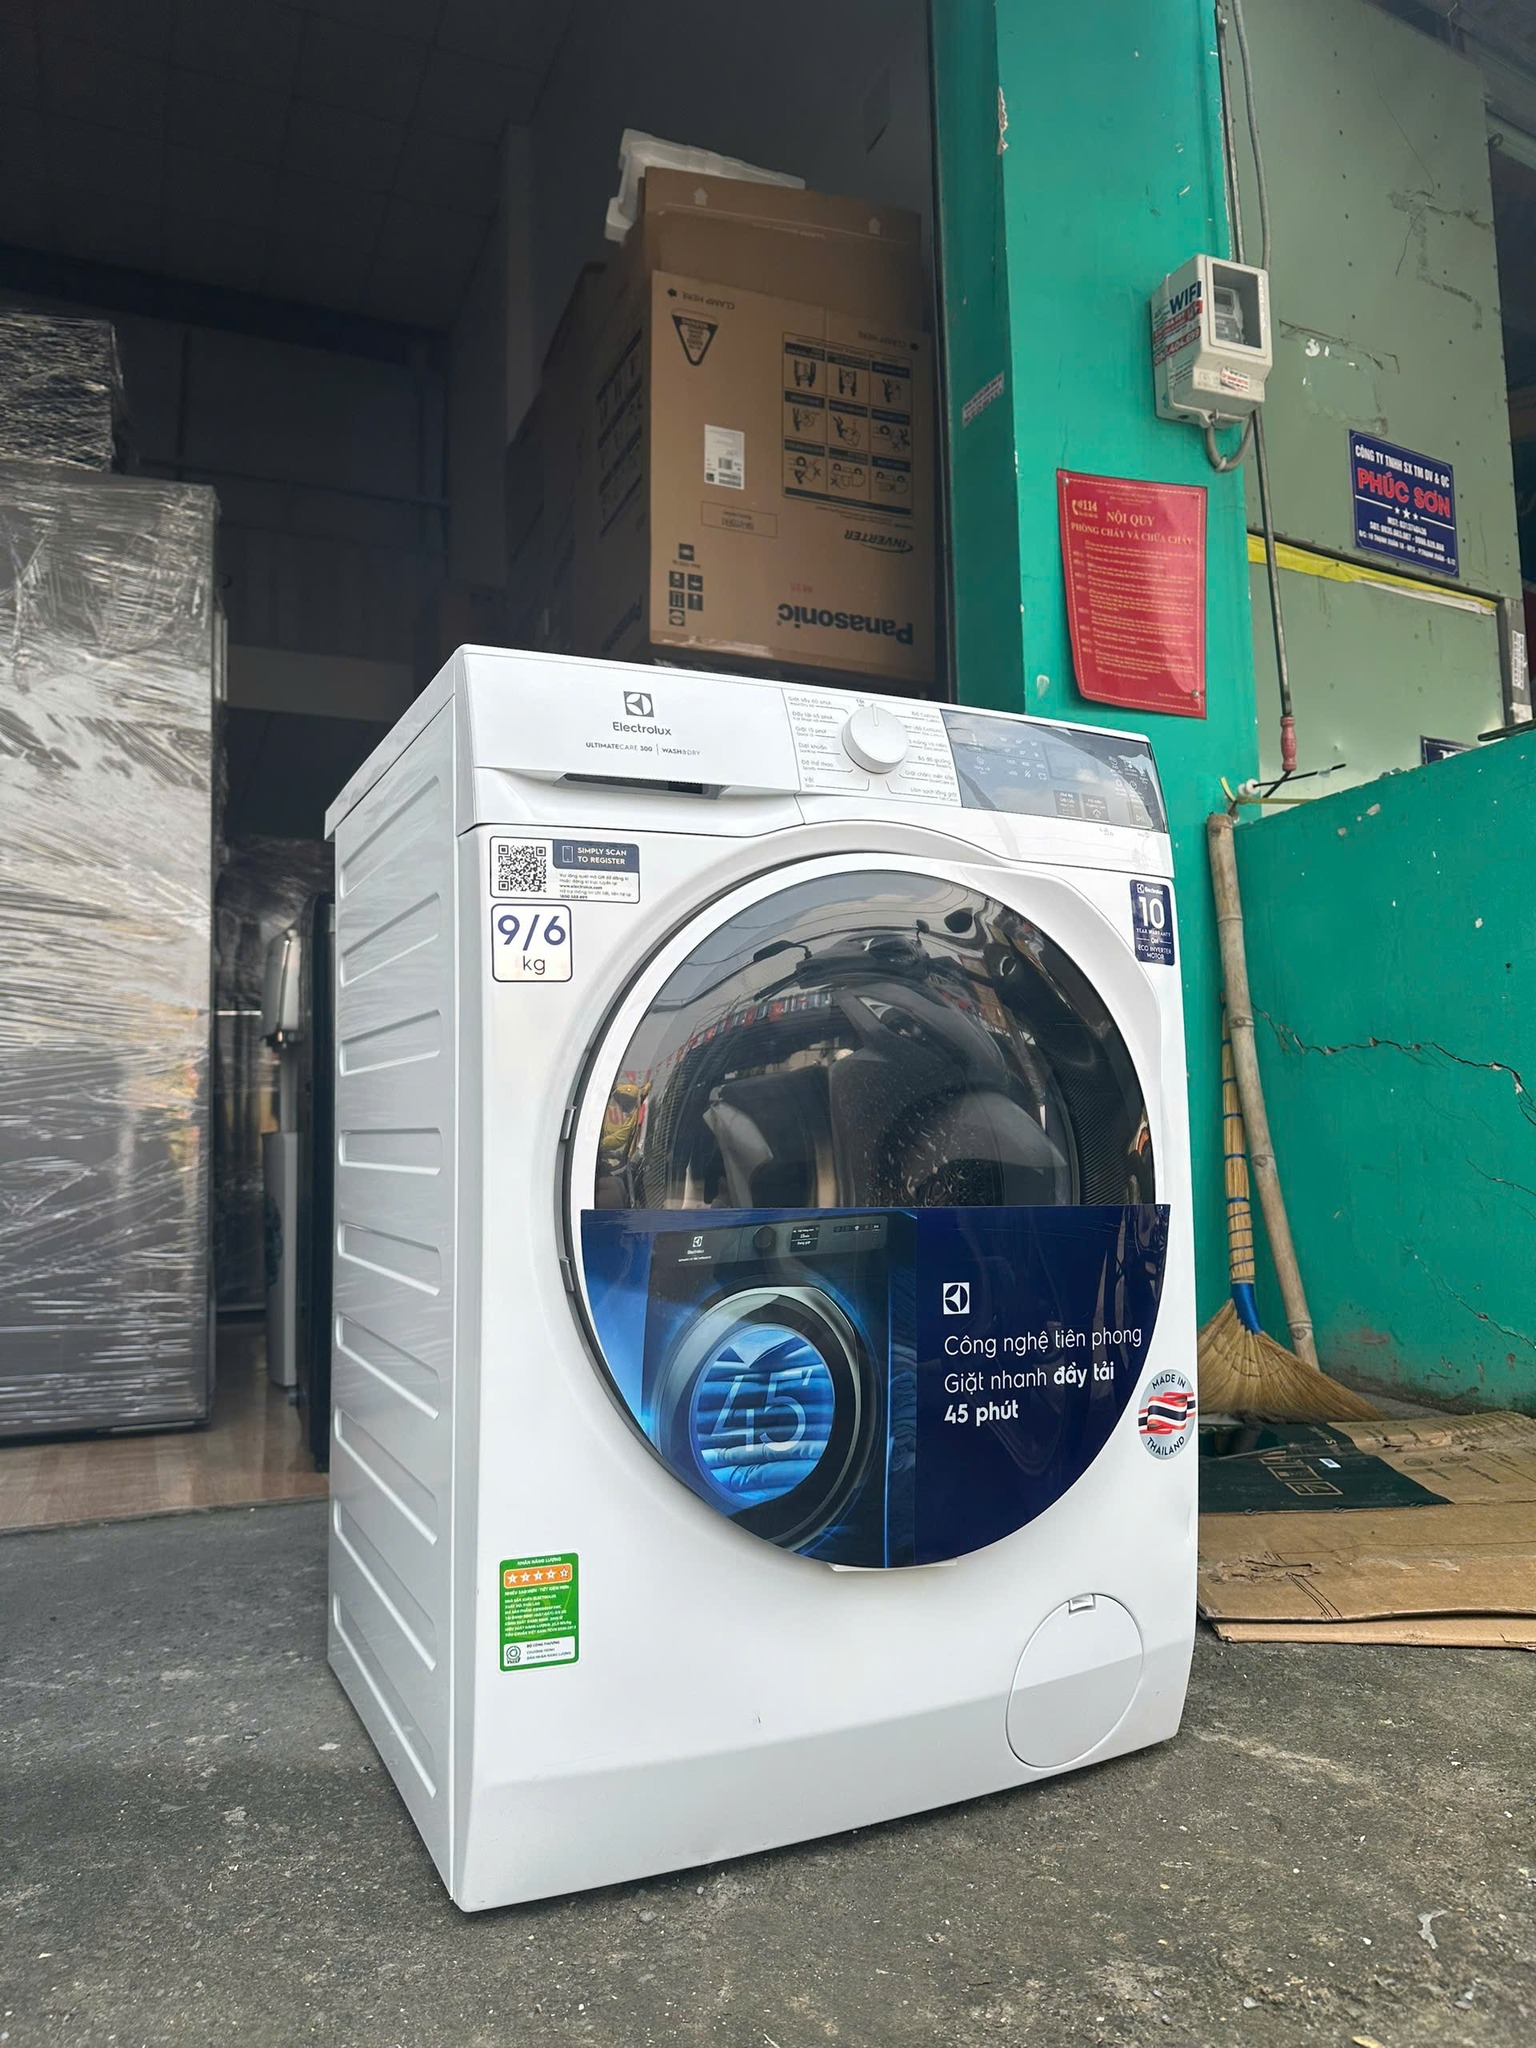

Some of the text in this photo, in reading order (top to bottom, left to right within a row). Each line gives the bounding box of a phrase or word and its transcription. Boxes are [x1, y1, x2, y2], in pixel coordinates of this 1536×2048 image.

[1170, 281, 1201, 314] WIFI
[1355, 444, 1374, 461] CÔNG
[1376, 452, 1384, 464] TY
[1404, 461, 1413, 475] SX
[1414, 465, 1424, 478] TM
[1441, 475, 1450, 488] QC
[1357, 467, 1450, 518] PHÚC SƠN
[1106, 510, 1127, 525] NỘI
[1130, 514, 1154, 528] QUY
[844, 529, 907, 548] INVERTER
[1071, 522, 1193, 546] PHÒNG CHÁY VÀ CHỮA CHÁY
[778, 604, 913, 645] Panasonic
[612, 722, 672, 736] Electrolux
[586, 742, 638, 752] ULTIMATECARE
[578, 847, 603, 855] SIMPLY
[590, 857, 625, 865] REGISTER
[1139, 896, 1165, 929] 10
[498, 914, 566, 951] 9/6
[1138, 944, 1171, 954] ECO INVERTER
[1147, 952, 1165, 960] MOTOR
[523, 955, 545, 976] kg
[944, 1327, 1142, 1358] Công nghệ tiên phong
[944, 1360, 1115, 1395] Giặt nhanh đầy tải
[1152, 1374, 1186, 1390] MADE IN
[944, 1399, 1019, 1426] 45 phút
[1147, 1436, 1185, 1455] THAILAND
